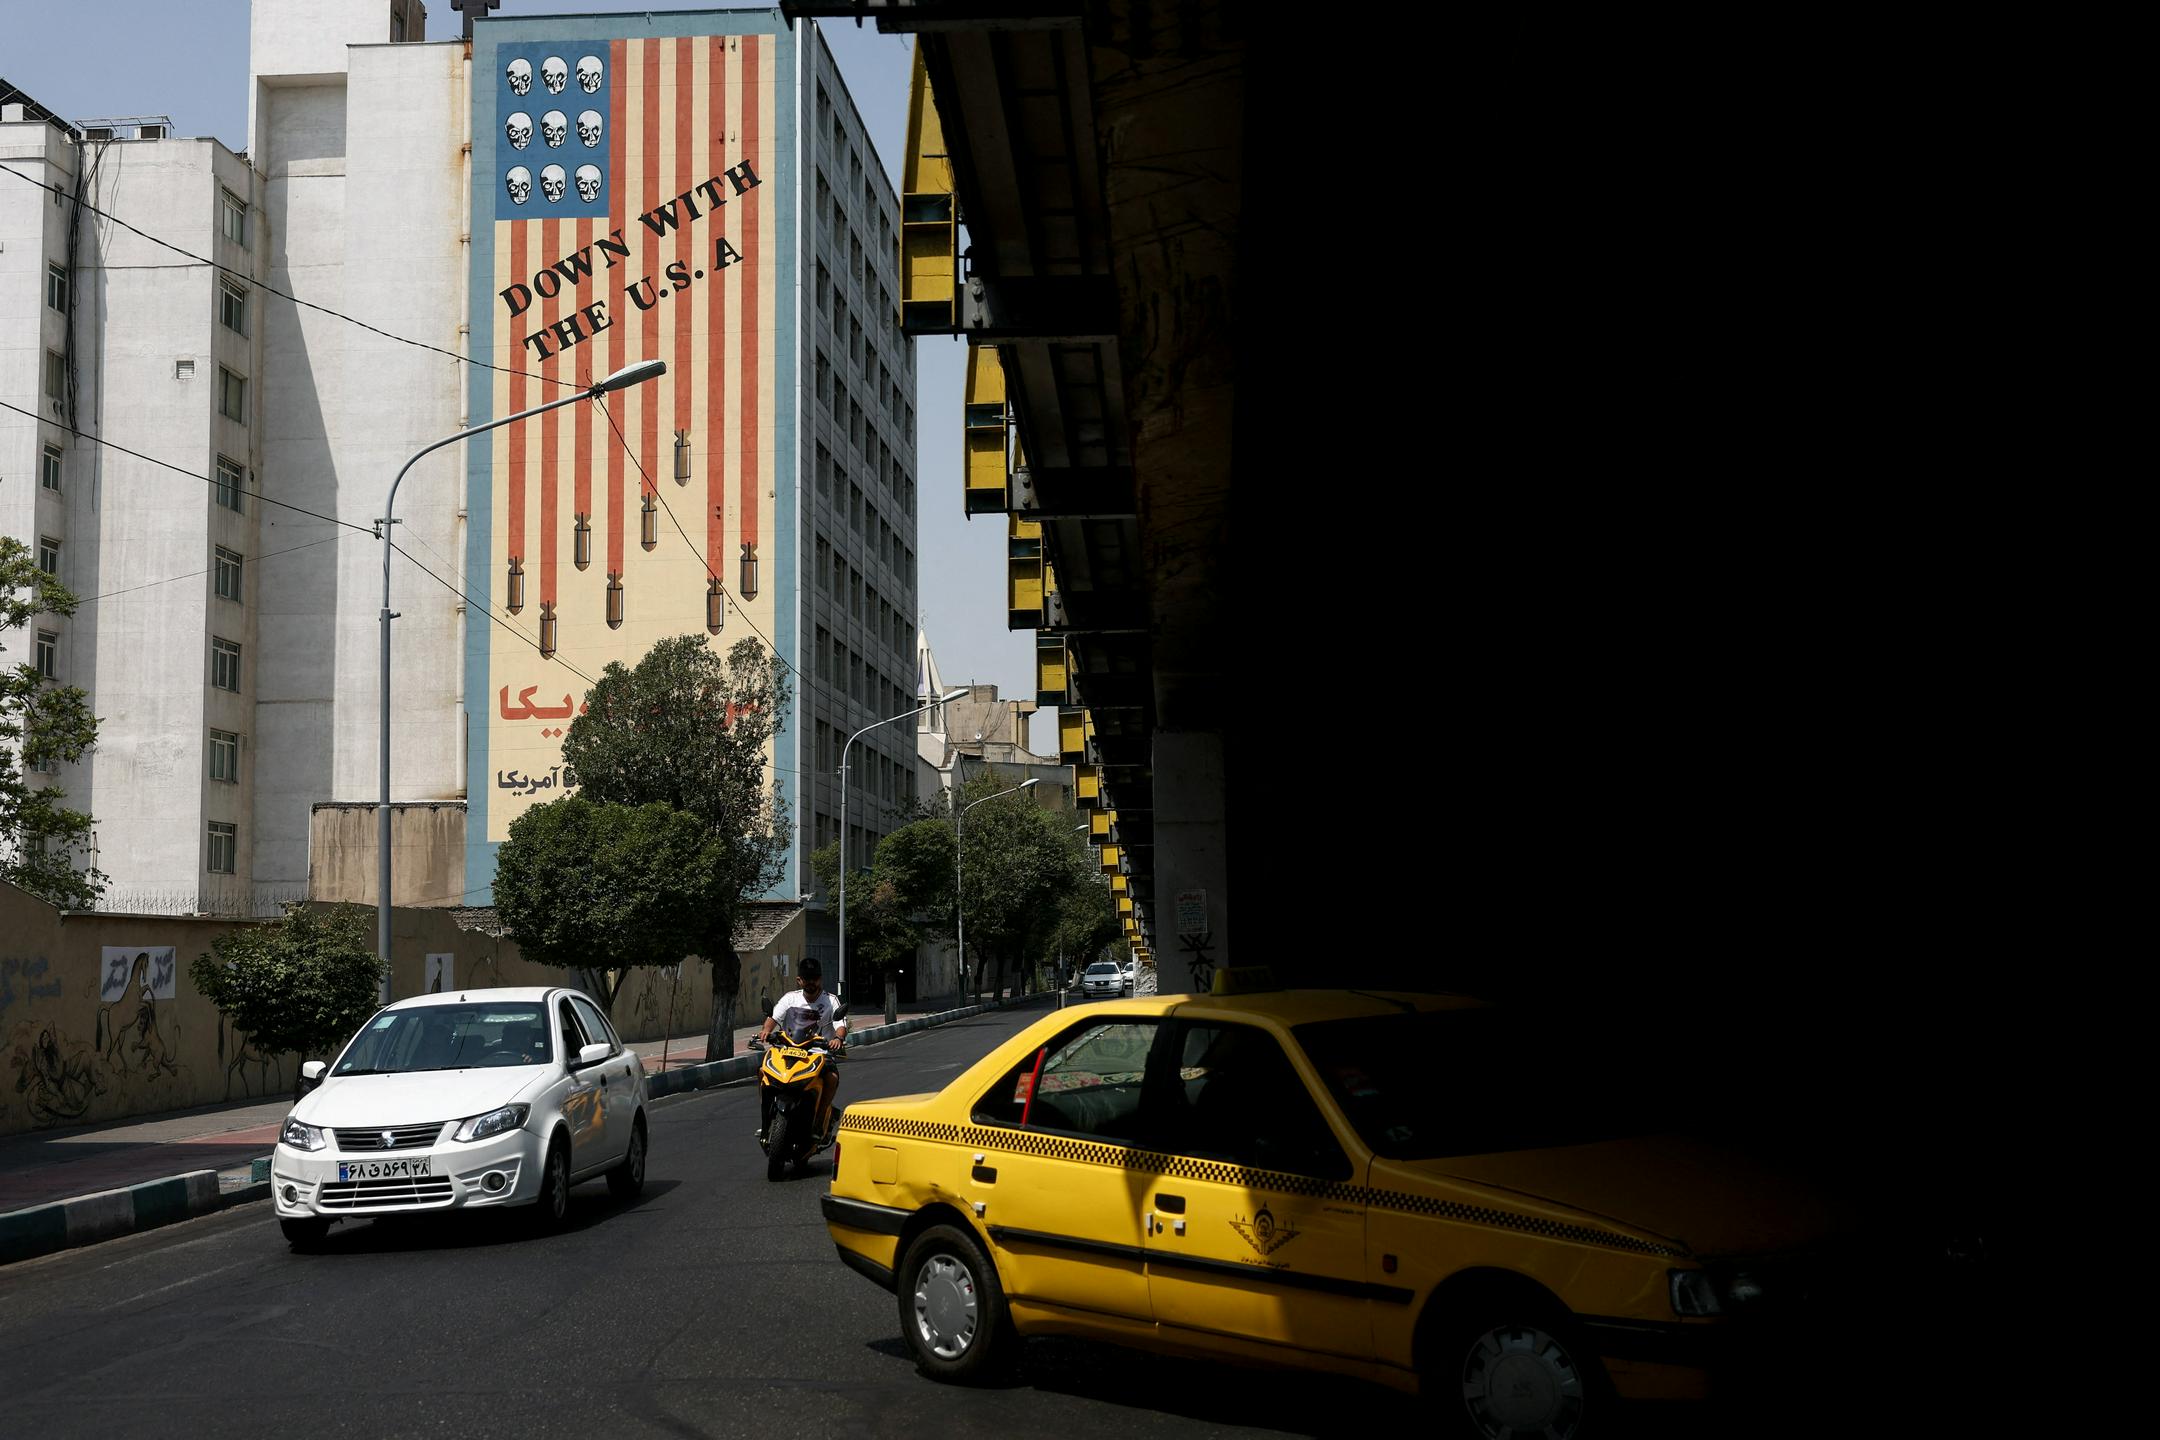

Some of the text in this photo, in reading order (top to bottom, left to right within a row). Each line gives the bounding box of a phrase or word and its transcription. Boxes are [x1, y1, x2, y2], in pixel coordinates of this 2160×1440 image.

[499, 159, 762, 318] DOWN WITH
[523, 300, 614, 362] THE
[497, 765, 562, 797] آمریکا
